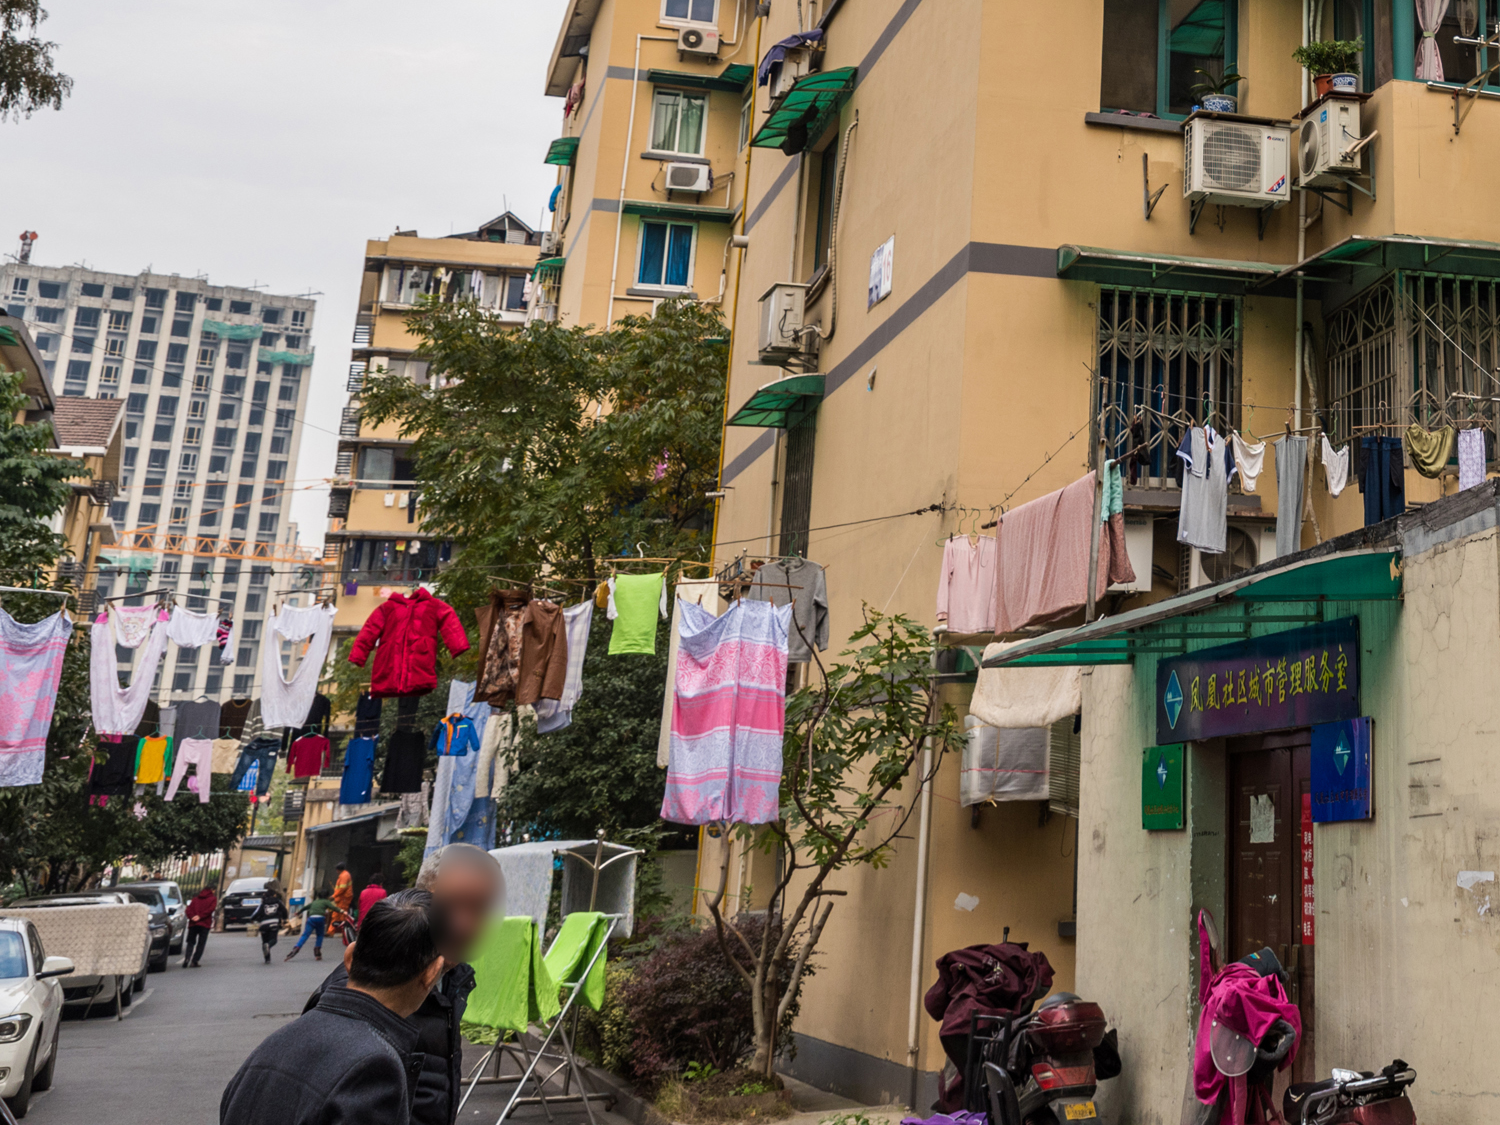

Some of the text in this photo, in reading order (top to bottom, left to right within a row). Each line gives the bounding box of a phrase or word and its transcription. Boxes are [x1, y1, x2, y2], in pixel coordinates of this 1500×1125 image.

[883, 249, 891, 286] 16
[1190, 644, 1348, 712] 凤凰社区城市管理服务室
